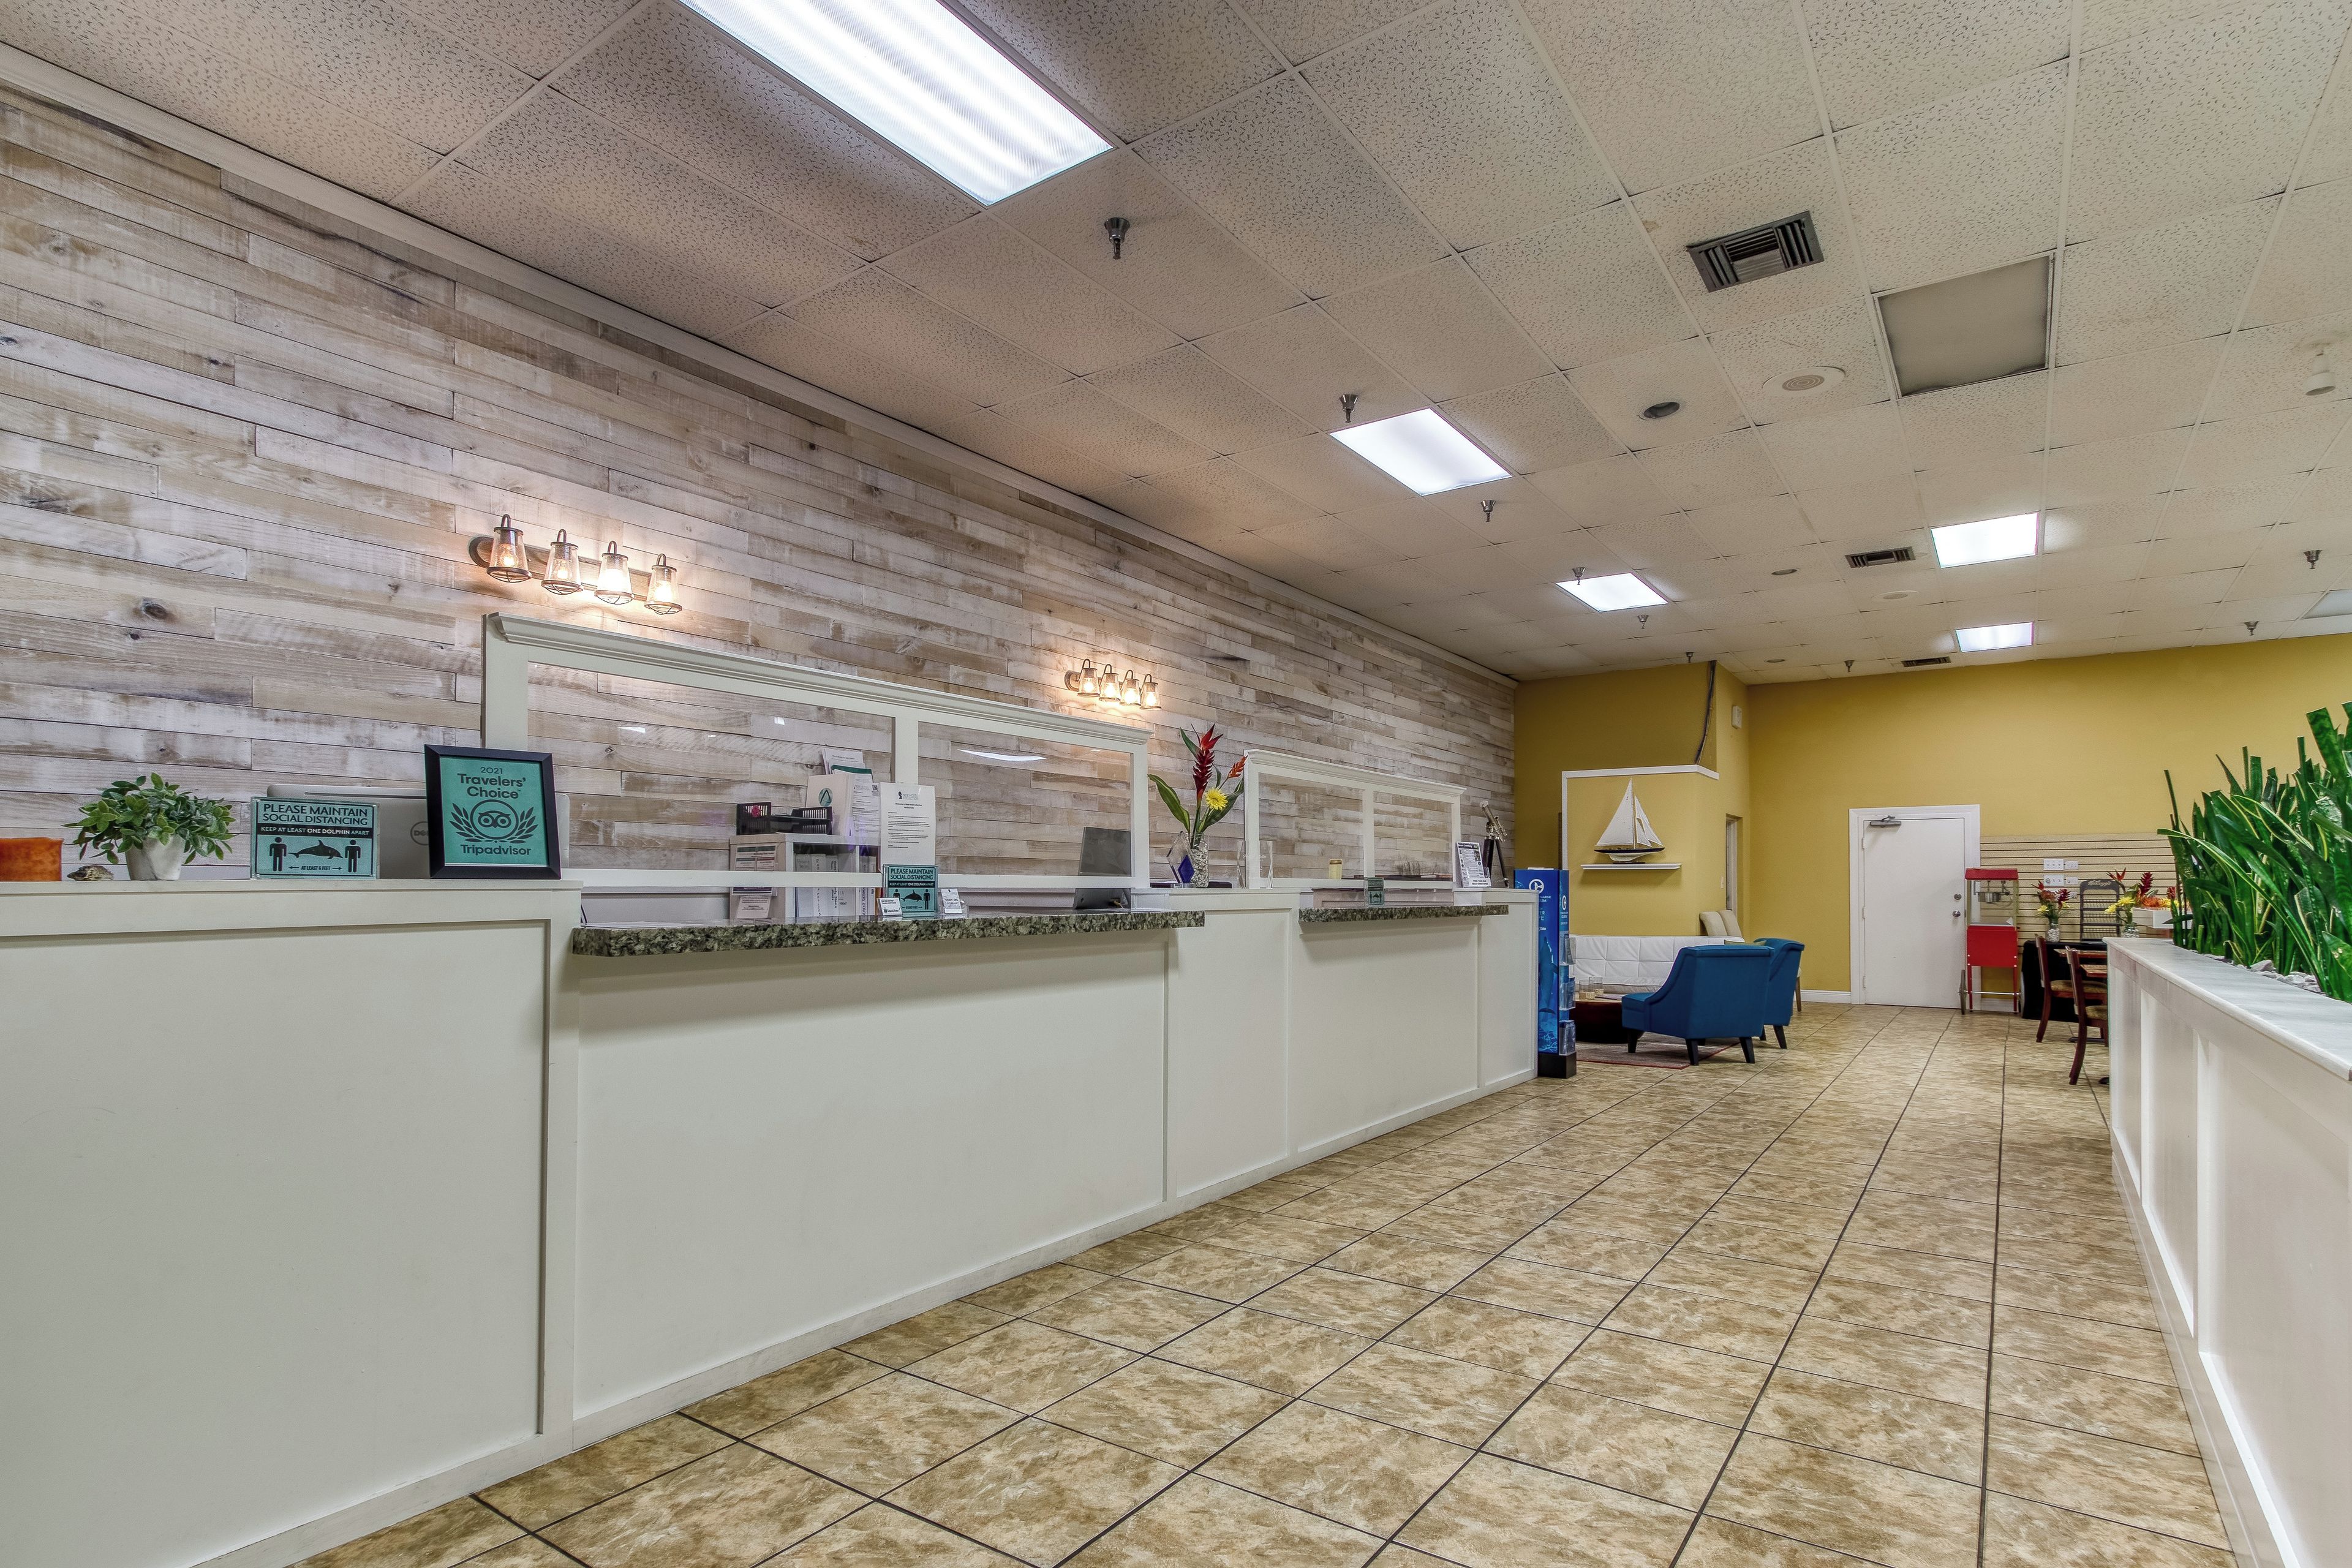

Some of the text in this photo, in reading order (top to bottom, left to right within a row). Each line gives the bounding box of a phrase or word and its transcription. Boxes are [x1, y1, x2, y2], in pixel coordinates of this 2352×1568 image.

[263, 804, 368, 817] PLEASE MAINTAIN
[263, 813, 368, 825] SOCIAL DISTANCING
[461, 844, 532, 856] Tripadvisor
